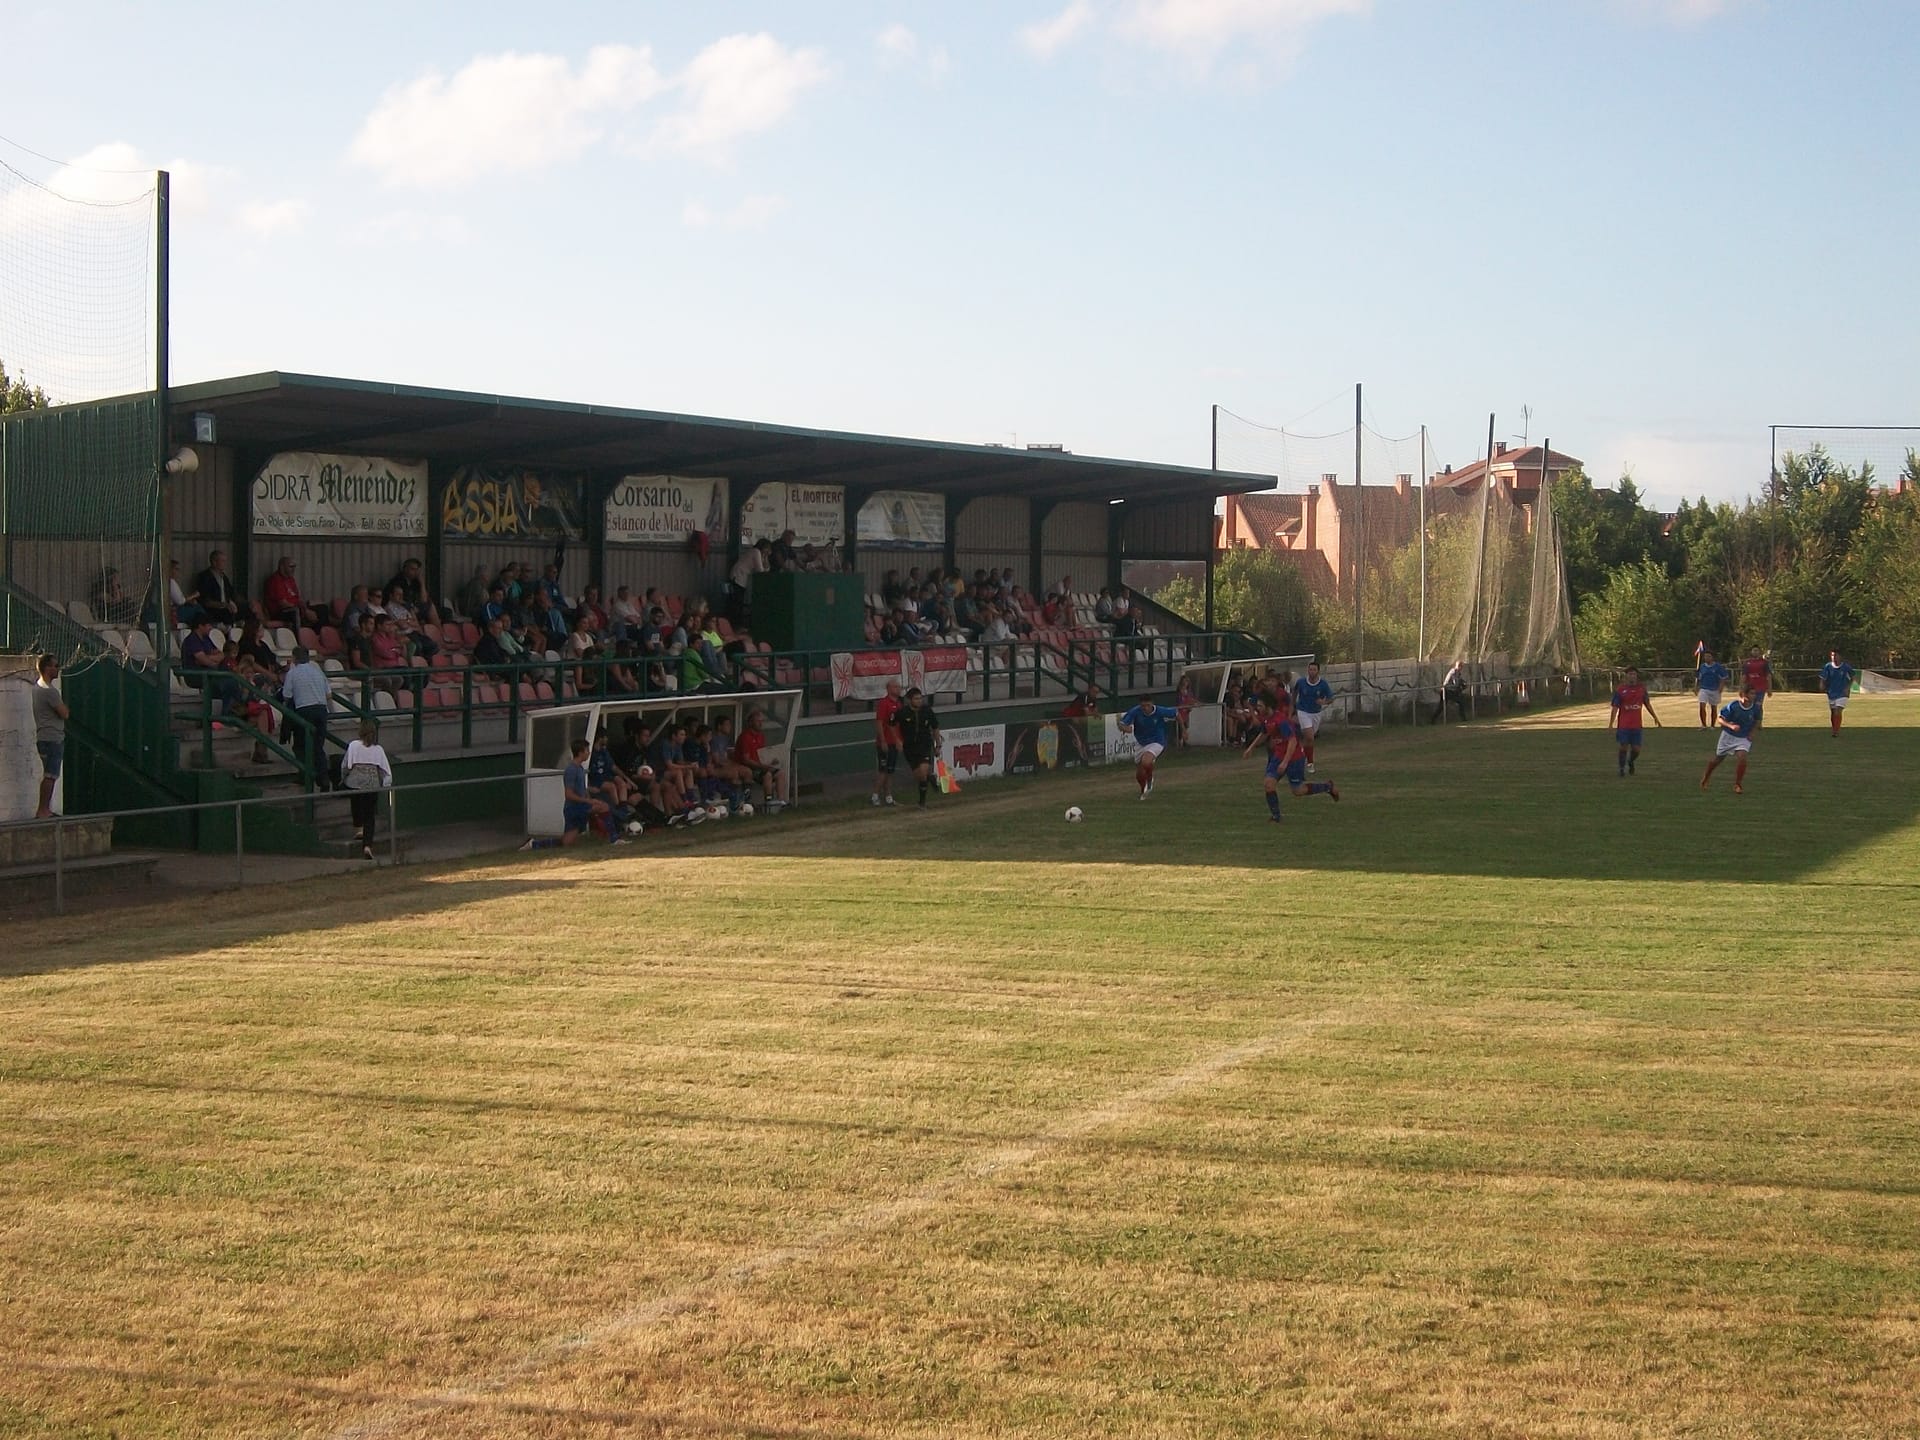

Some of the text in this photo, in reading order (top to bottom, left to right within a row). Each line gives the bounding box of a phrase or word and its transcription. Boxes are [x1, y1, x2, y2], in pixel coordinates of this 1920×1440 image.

[257, 463, 415, 513] SIDRA Menéndez
[612, 486, 682, 508] Corsario
[791, 489, 800, 503] EL
[606, 511, 696, 532] Estanco de Mareo
